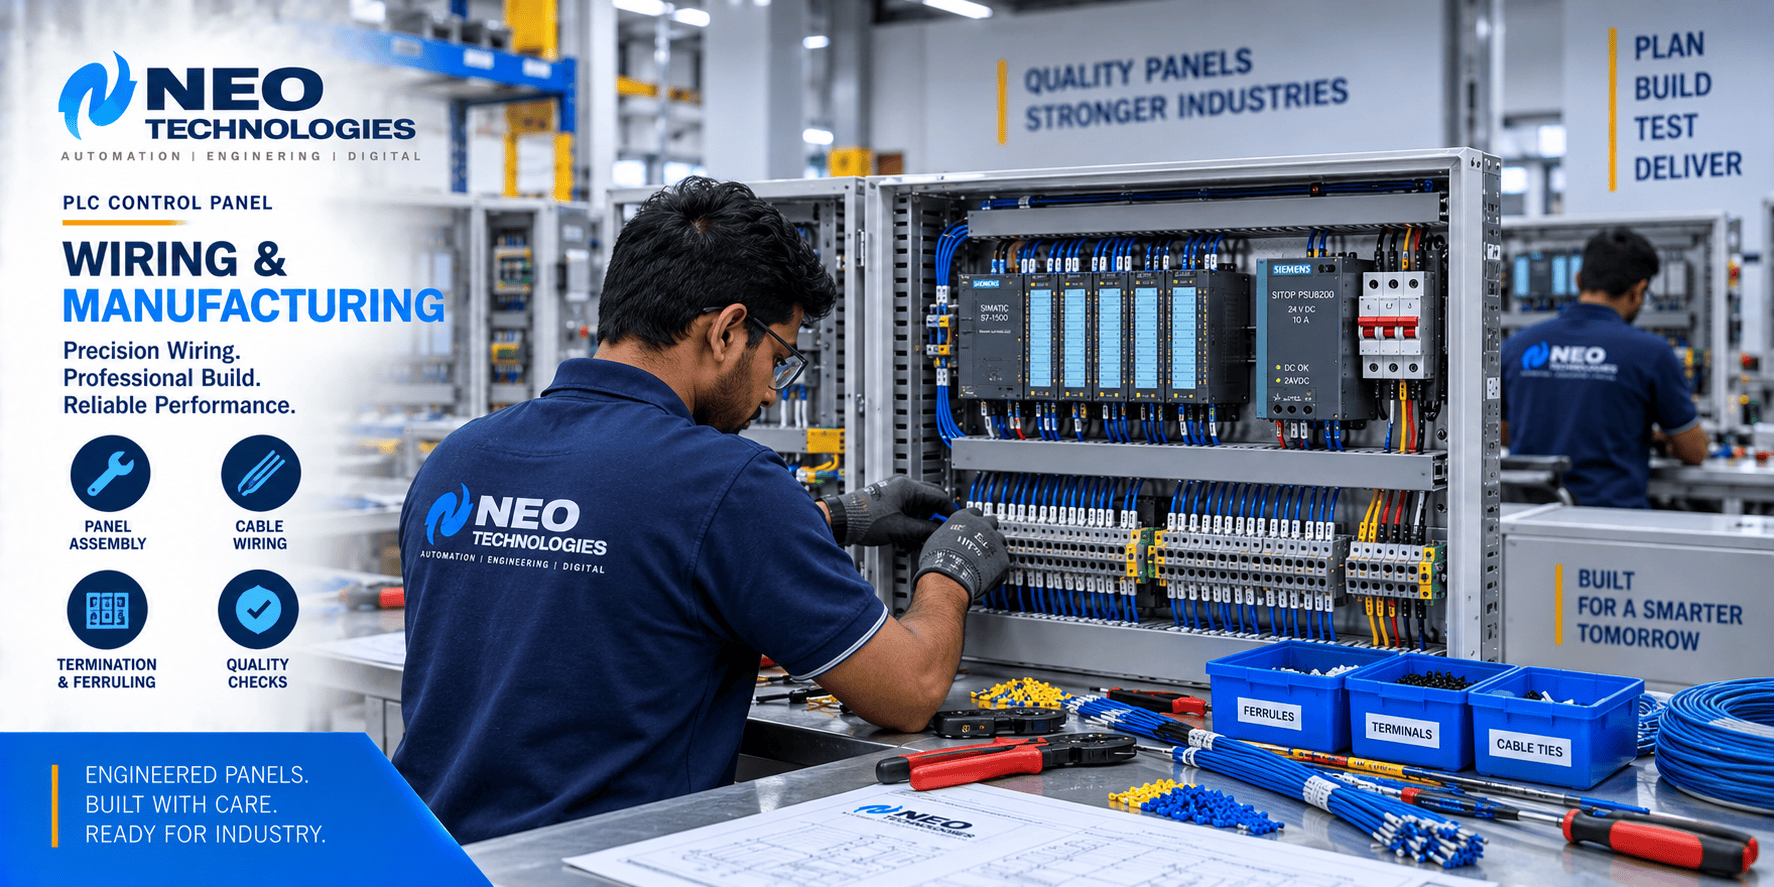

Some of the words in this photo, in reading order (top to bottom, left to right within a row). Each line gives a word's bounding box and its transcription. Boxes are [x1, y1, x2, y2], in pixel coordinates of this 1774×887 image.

[1635, 31, 1704, 61] PLAN
[1024, 58, 1134, 95] QUALITY
[1145, 47, 1253, 83] PANELS
[1635, 71, 1712, 101] BUILD
[1025, 95, 1167, 132] STRONGER
[1178, 77, 1349, 119] INDUSTRIES
[1634, 113, 1698, 141] TEST
[1635, 151, 1742, 182] DELIVER
[1274, 264, 1311, 274] SIEMENS
[1272, 290, 1296, 299] SITOP
[1298, 290, 1335, 299] PSU8200
[980, 304, 1009, 312] SIMATIC
[1550, 345, 1607, 364] NEO
[1284, 364, 1296, 372] DC
[1297, 364, 1309, 372] OK
[475, 495, 580, 532] NEO
[472, 531, 608, 556] TECHNOLOGIES
[420, 550, 476, 562] AUTOMATION
[487, 555, 549, 569] ENGINEERING
[563, 562, 605, 574] DIGITAL
[1578, 568, 1635, 590] BUILT
[1578, 596, 1616, 617] FOR
[1623, 598, 1637, 618] A
[1643, 599, 1743, 625] SMARTER
[1577, 623, 1701, 651] TOMORROW
[1243, 705, 1295, 722] FERRULES
[1372, 721, 1433, 740] TERMINALS
[1497, 738, 1534, 755] CABLE
[1537, 744, 1563, 757] TIES
[893, 810, 973, 829] NEO
